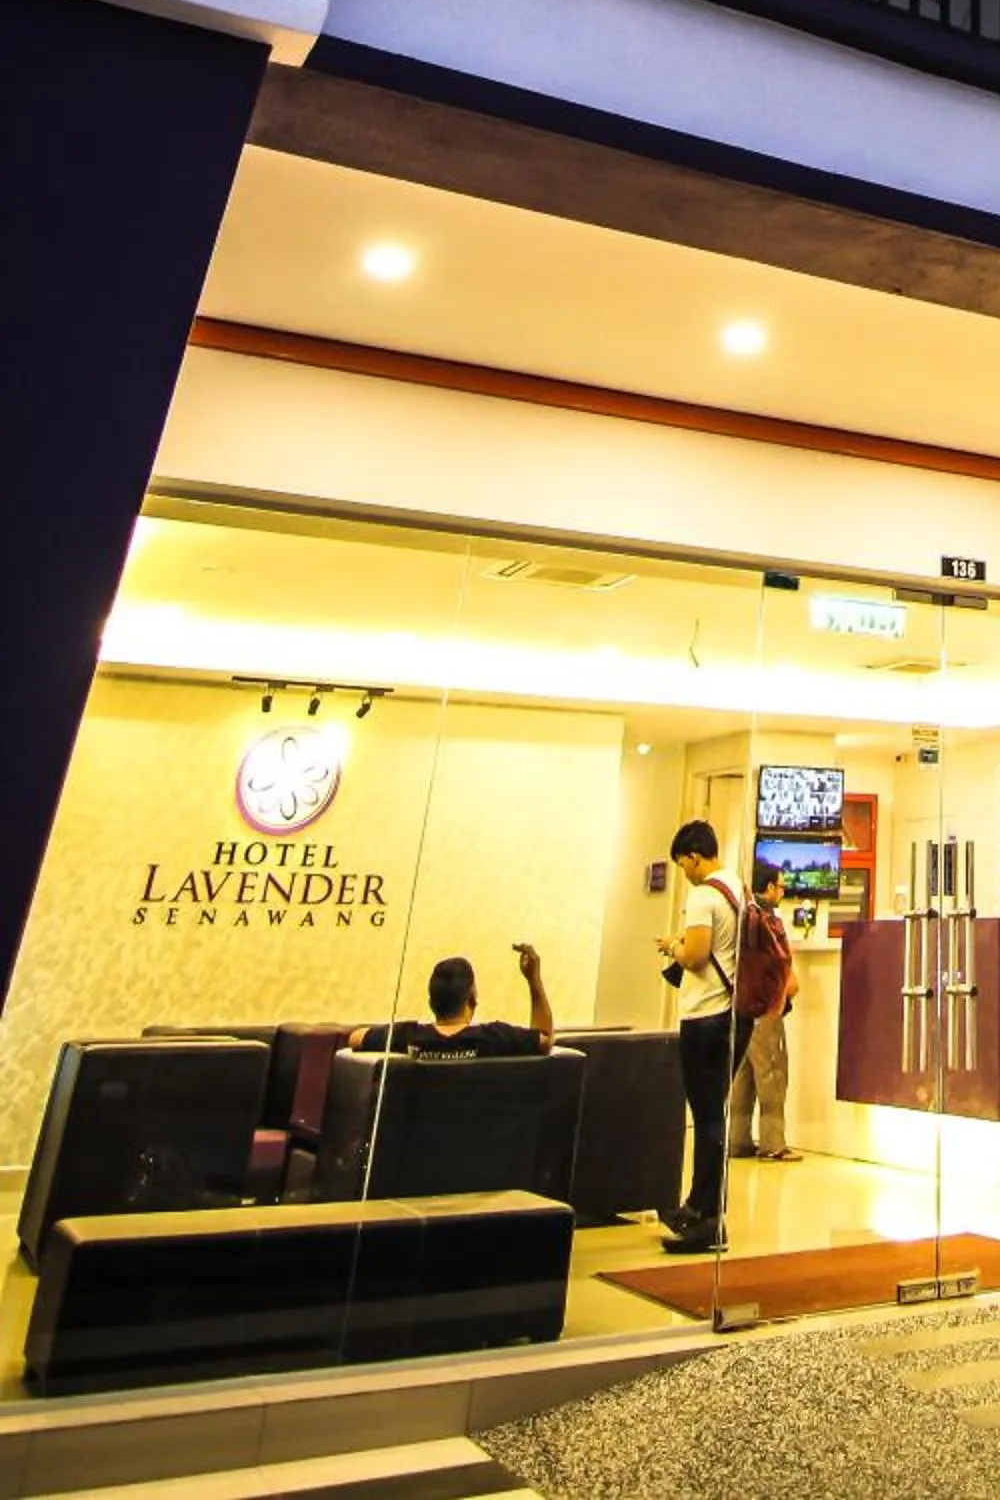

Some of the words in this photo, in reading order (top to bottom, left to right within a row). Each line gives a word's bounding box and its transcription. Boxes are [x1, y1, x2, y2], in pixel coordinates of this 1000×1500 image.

[951, 560, 977, 579] 136
[212, 841, 338, 869] HOTEL
[140, 862, 388, 906] LAVENDER
[132, 908, 386, 928] SENAWANG
